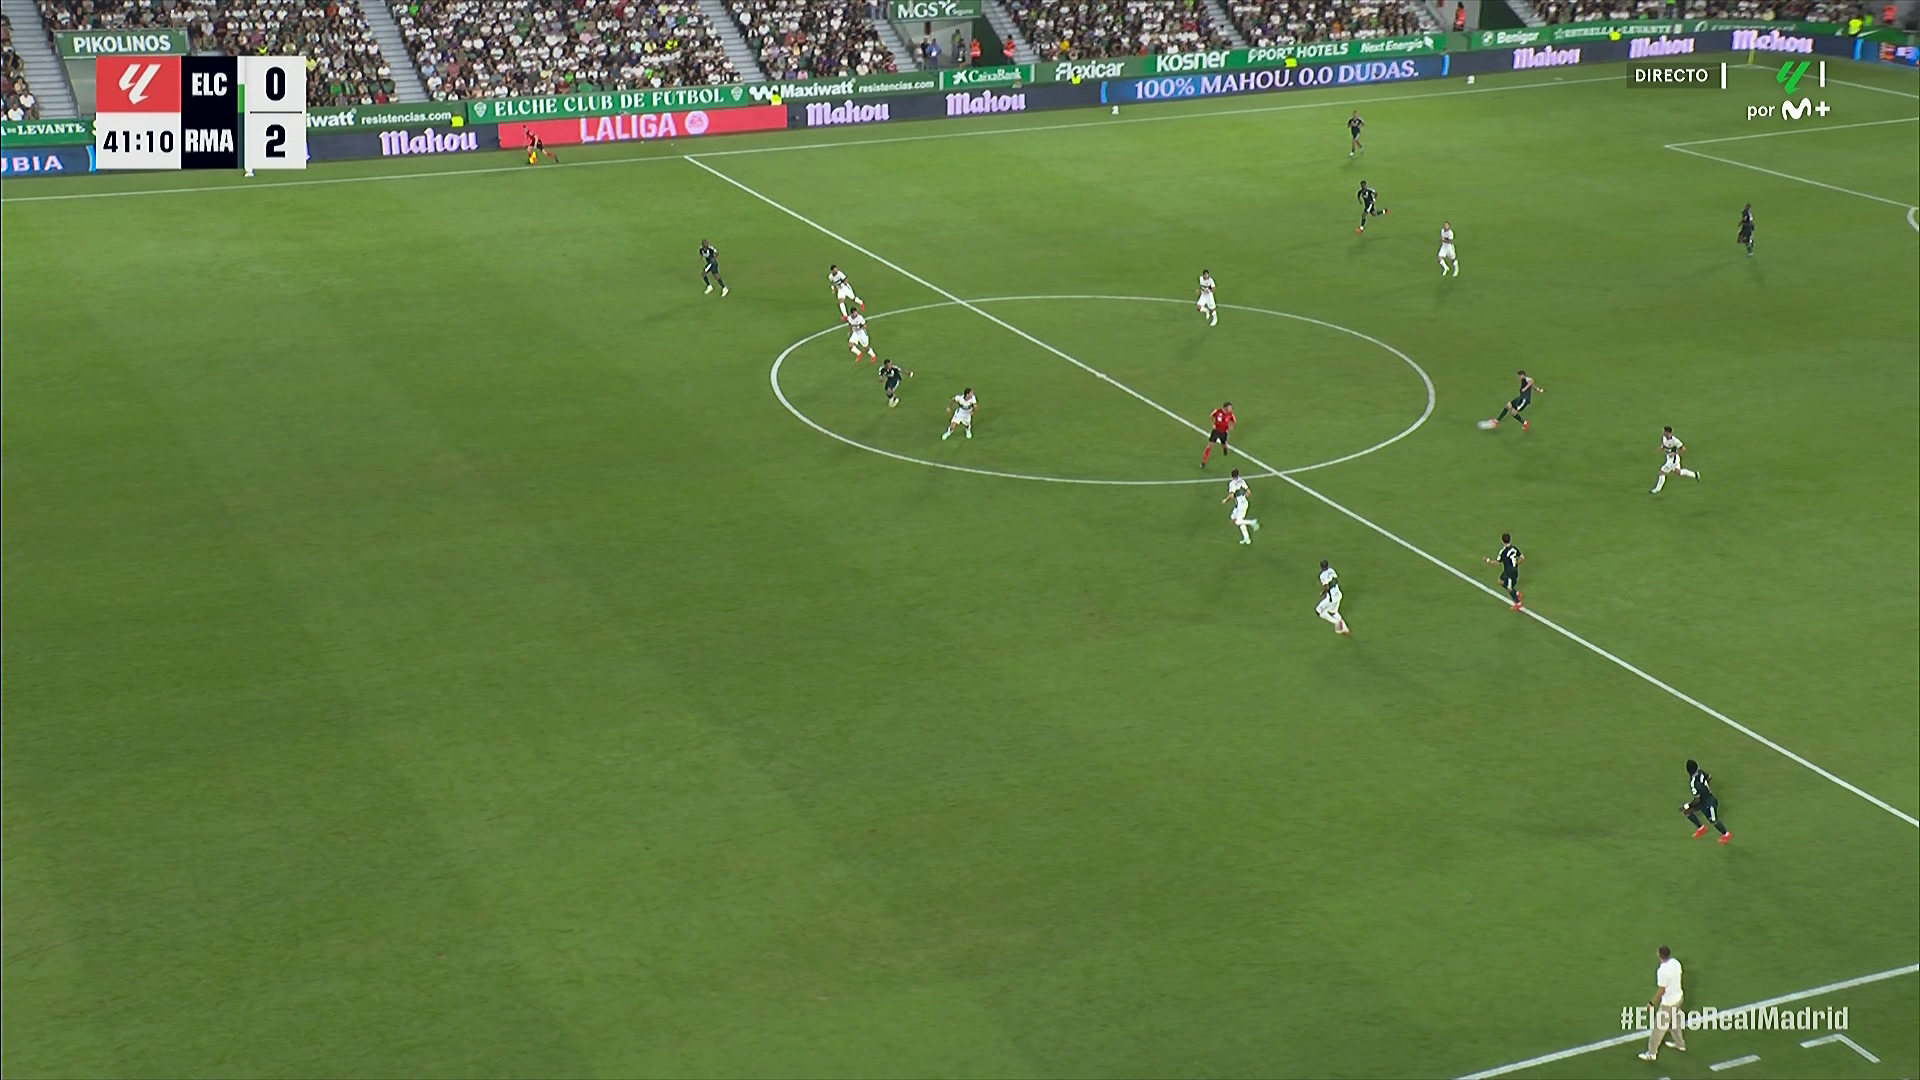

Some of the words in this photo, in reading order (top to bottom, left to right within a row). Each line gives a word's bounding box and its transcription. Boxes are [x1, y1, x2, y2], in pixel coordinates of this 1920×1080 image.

[897, 2, 939, 19] MGS
[73, 35, 172, 53] PIKOLINOS
[1296, 43, 1349, 58] HOTELS
[1360, 42, 1385, 53] Next
[1629, 35, 1695, 59] Mahou
[1734, 29, 1814, 53] Mahou
[1512, 45, 1581, 70] Mahou
[780, 81, 854, 99] Maxiwatt
[858, 80, 935, 93] resistencias.com
[1135, 78, 1195, 99] 100%
[1200, 70, 1294, 92] MAHOU.
[1298, 66, 1333, 86] 0.0
[1338, 60, 1419, 83] DUDAS.
[495, 98, 557, 117] ELCHE
[563, 95, 613, 112] CLUB
[620, 92, 645, 109] DE
[805, 100, 890, 126] Mahou
[946, 90, 1026, 116] Mahou
[17, 123, 86, 136] LEVANTE
[361, 111, 452, 125] resistencias.com
[581, 113, 677, 142] LALIGA
[379, 127, 479, 156] Mahou
